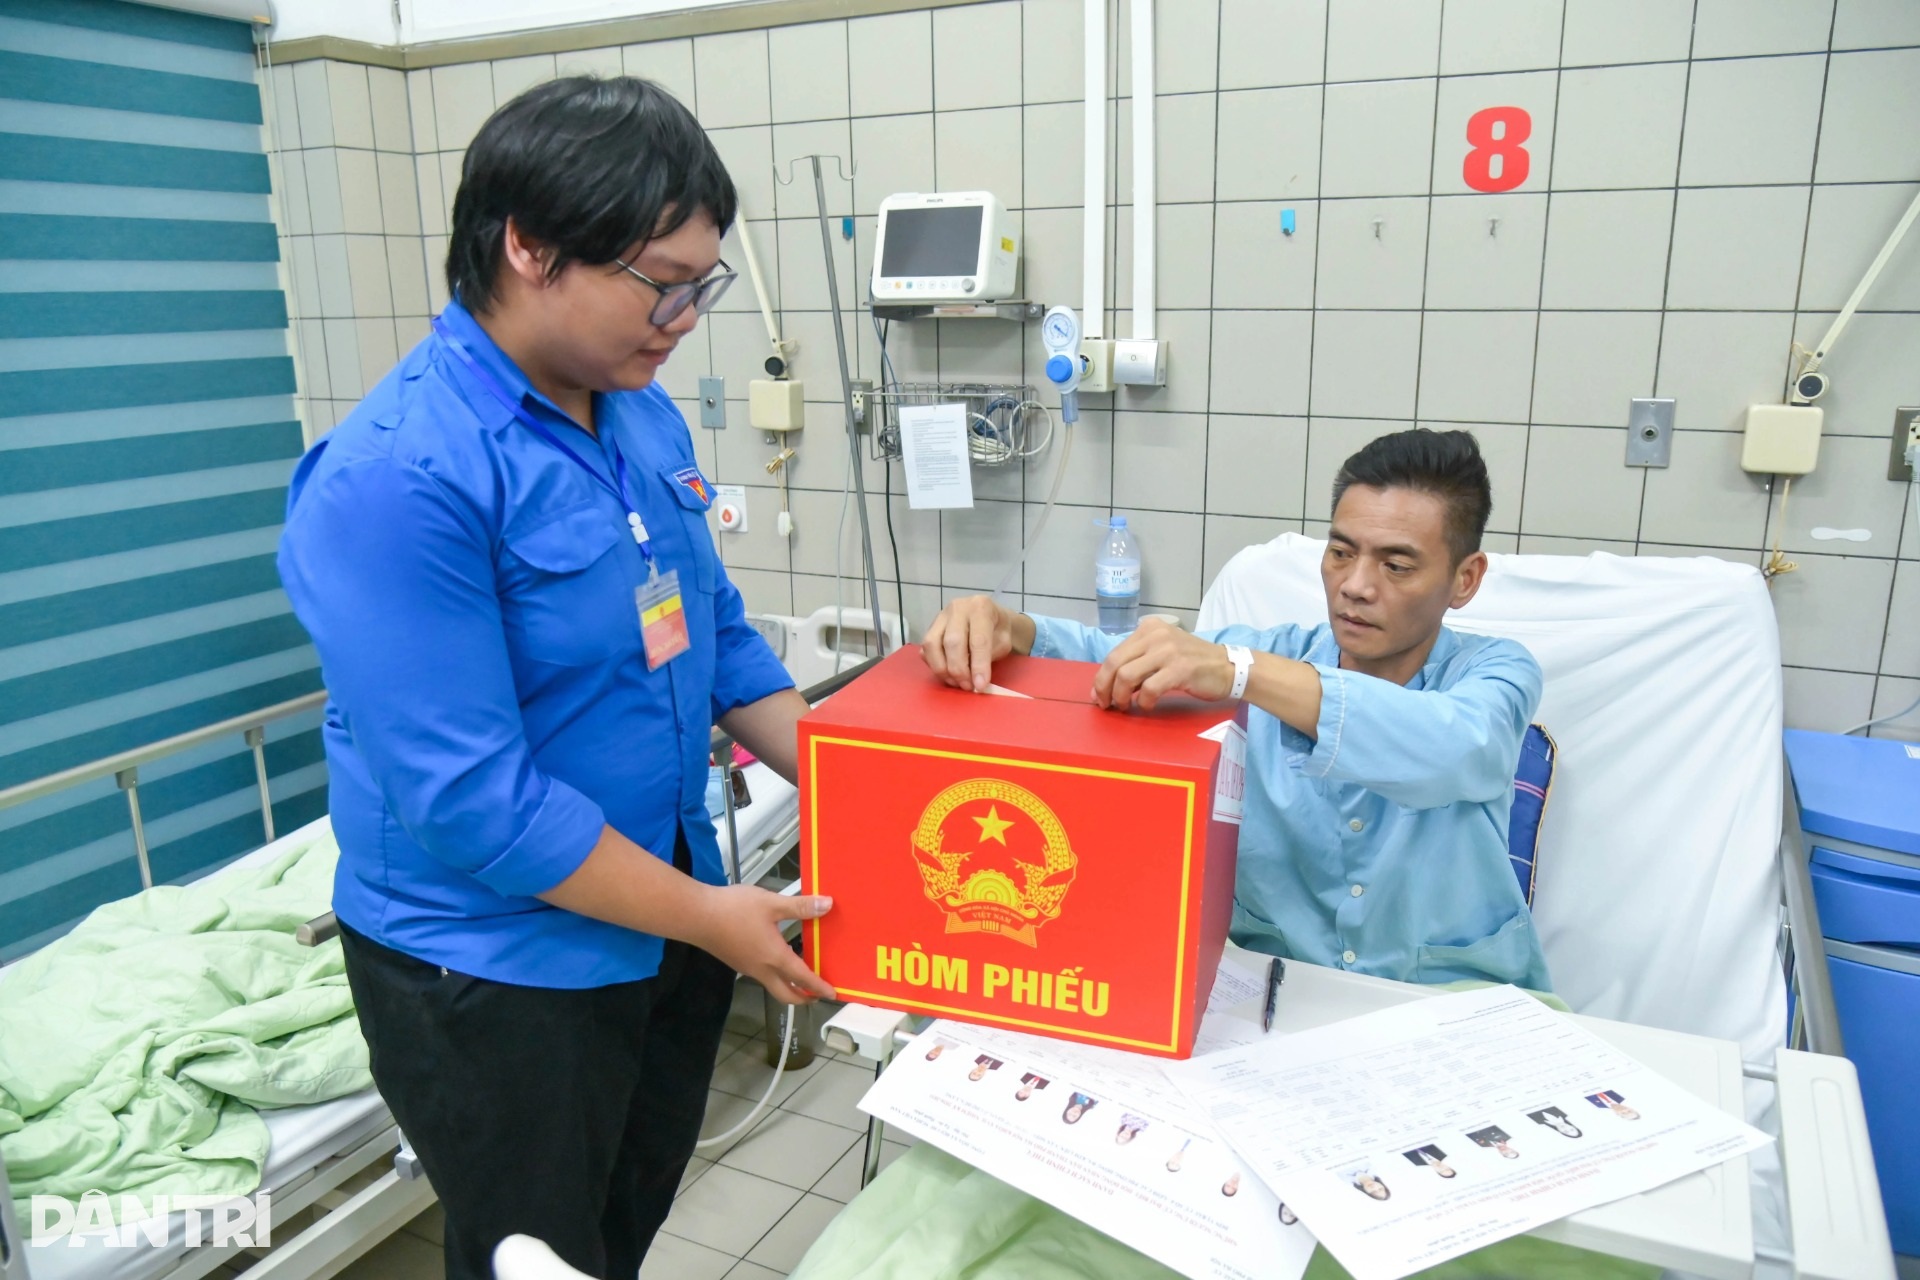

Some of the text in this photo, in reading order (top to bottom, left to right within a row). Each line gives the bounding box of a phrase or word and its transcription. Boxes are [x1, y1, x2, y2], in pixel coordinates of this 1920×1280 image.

[1463, 106, 1532, 194] 8
[971, 910, 1012, 924] VIỆT NAM
[877, 941, 1109, 1017] HÒM PHIẾU
